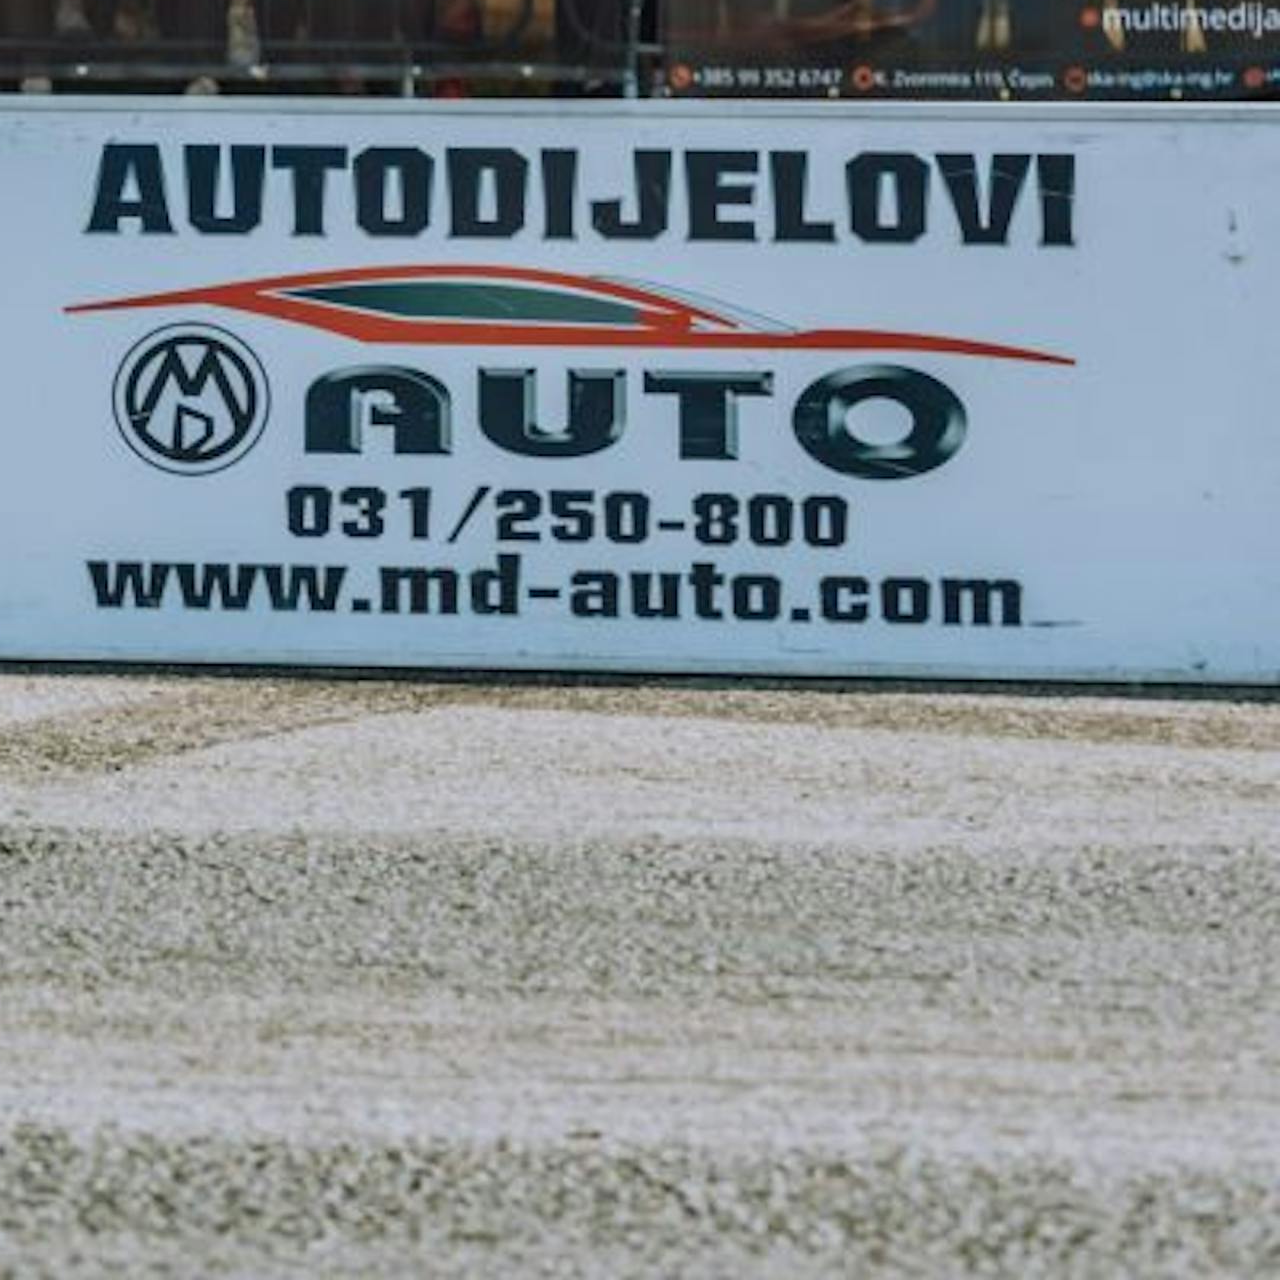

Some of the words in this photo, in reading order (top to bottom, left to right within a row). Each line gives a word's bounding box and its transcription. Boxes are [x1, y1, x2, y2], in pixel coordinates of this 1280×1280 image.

[82, 142, 1077, 246] AUTODIJELOVI
[304, 363, 968, 481] AUTO
[285, 483, 849, 548] 031/250-800
[86, 552, 1023, 627] www.md-auto.com
